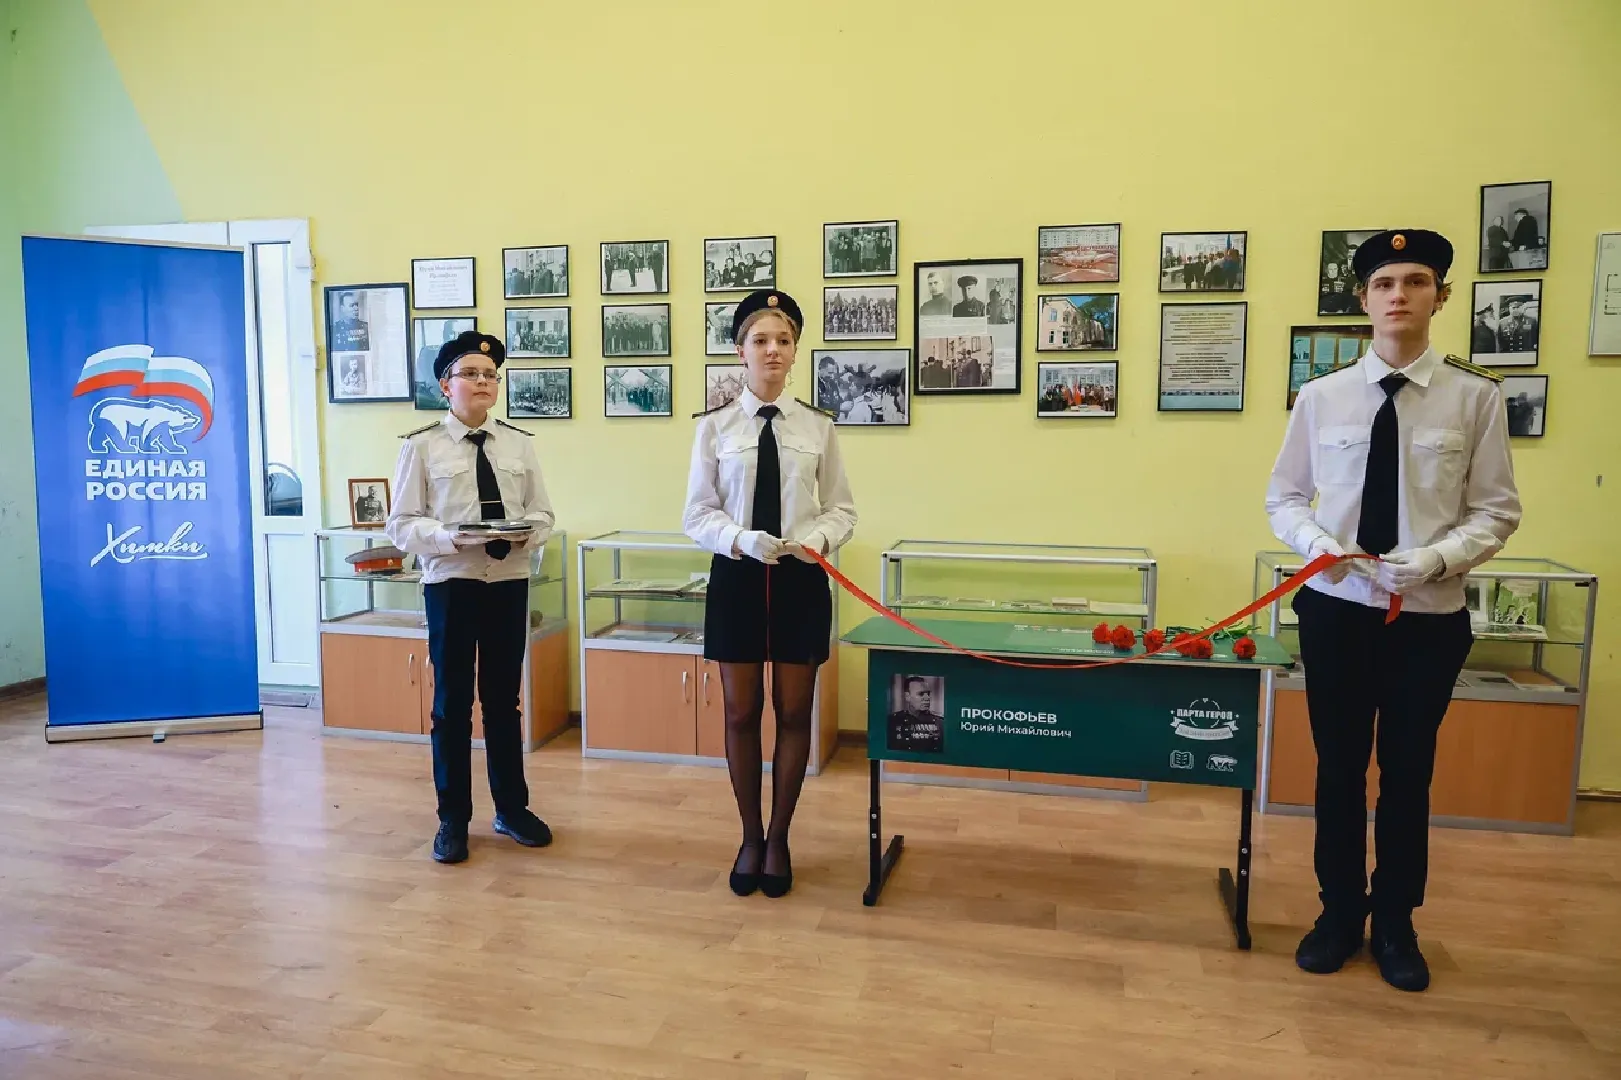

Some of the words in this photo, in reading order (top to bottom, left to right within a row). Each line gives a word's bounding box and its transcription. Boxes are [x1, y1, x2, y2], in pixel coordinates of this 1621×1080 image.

[85, 459, 206, 479] ЕДИНАЯ
[86, 481, 207, 501] РОССИЯ
[90, 521, 208, 568] Химки
[961, 707, 1058, 724] ПРОКОФЬЕВ
[1176, 708, 1205, 718] ПАРТА
[960, 721, 995, 733] Юрий
[996, 724, 1072, 738] Михайлович
